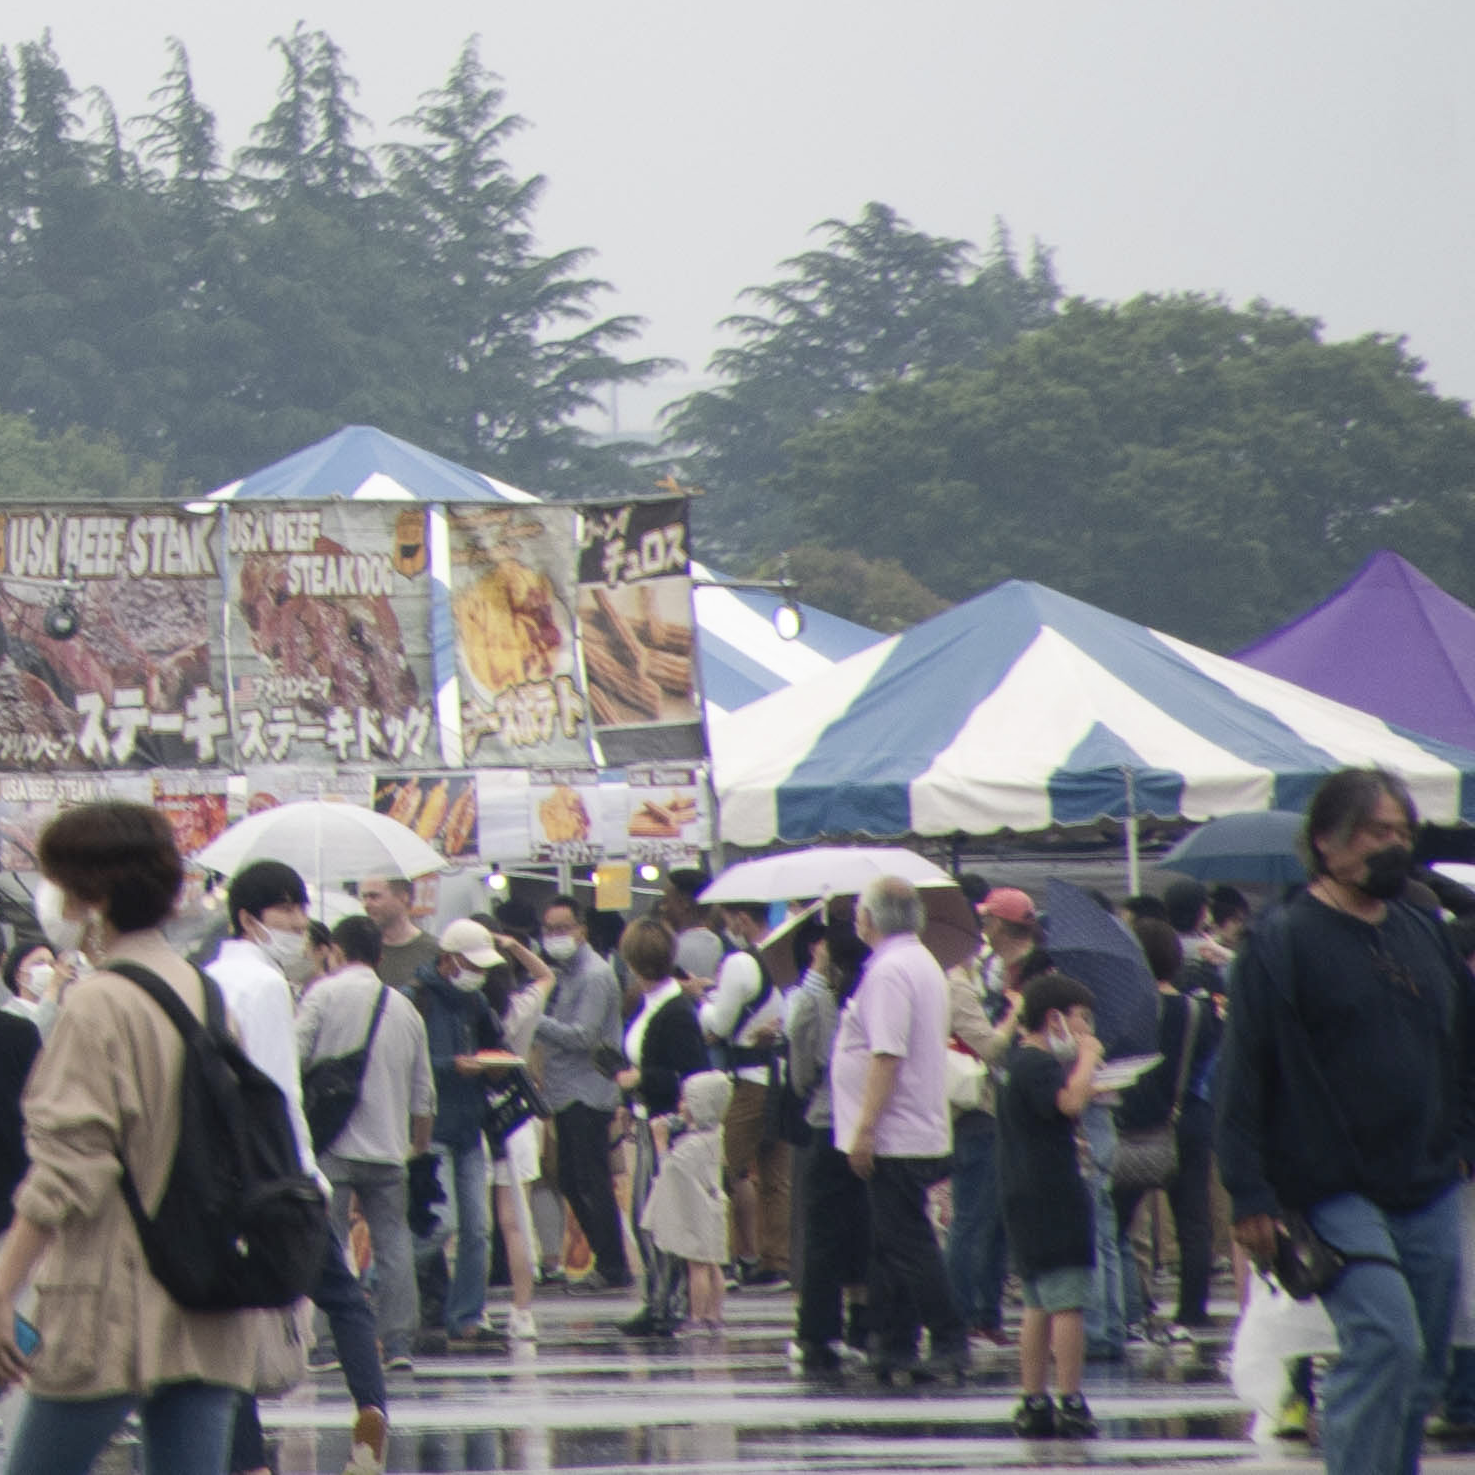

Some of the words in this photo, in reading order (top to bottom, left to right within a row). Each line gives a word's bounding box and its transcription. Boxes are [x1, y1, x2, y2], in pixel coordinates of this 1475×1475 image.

[9, 516, 62, 577] USA
[63, 515, 128, 577] BEEF
[128, 514, 220, 577] STEAK
[230, 512, 269, 553] USA
[272, 511, 323, 553] BEEF
[287, 555, 355, 596] STEAK
[357, 554, 396, 596] DOG
[75, 684, 229, 765] ステーキ
